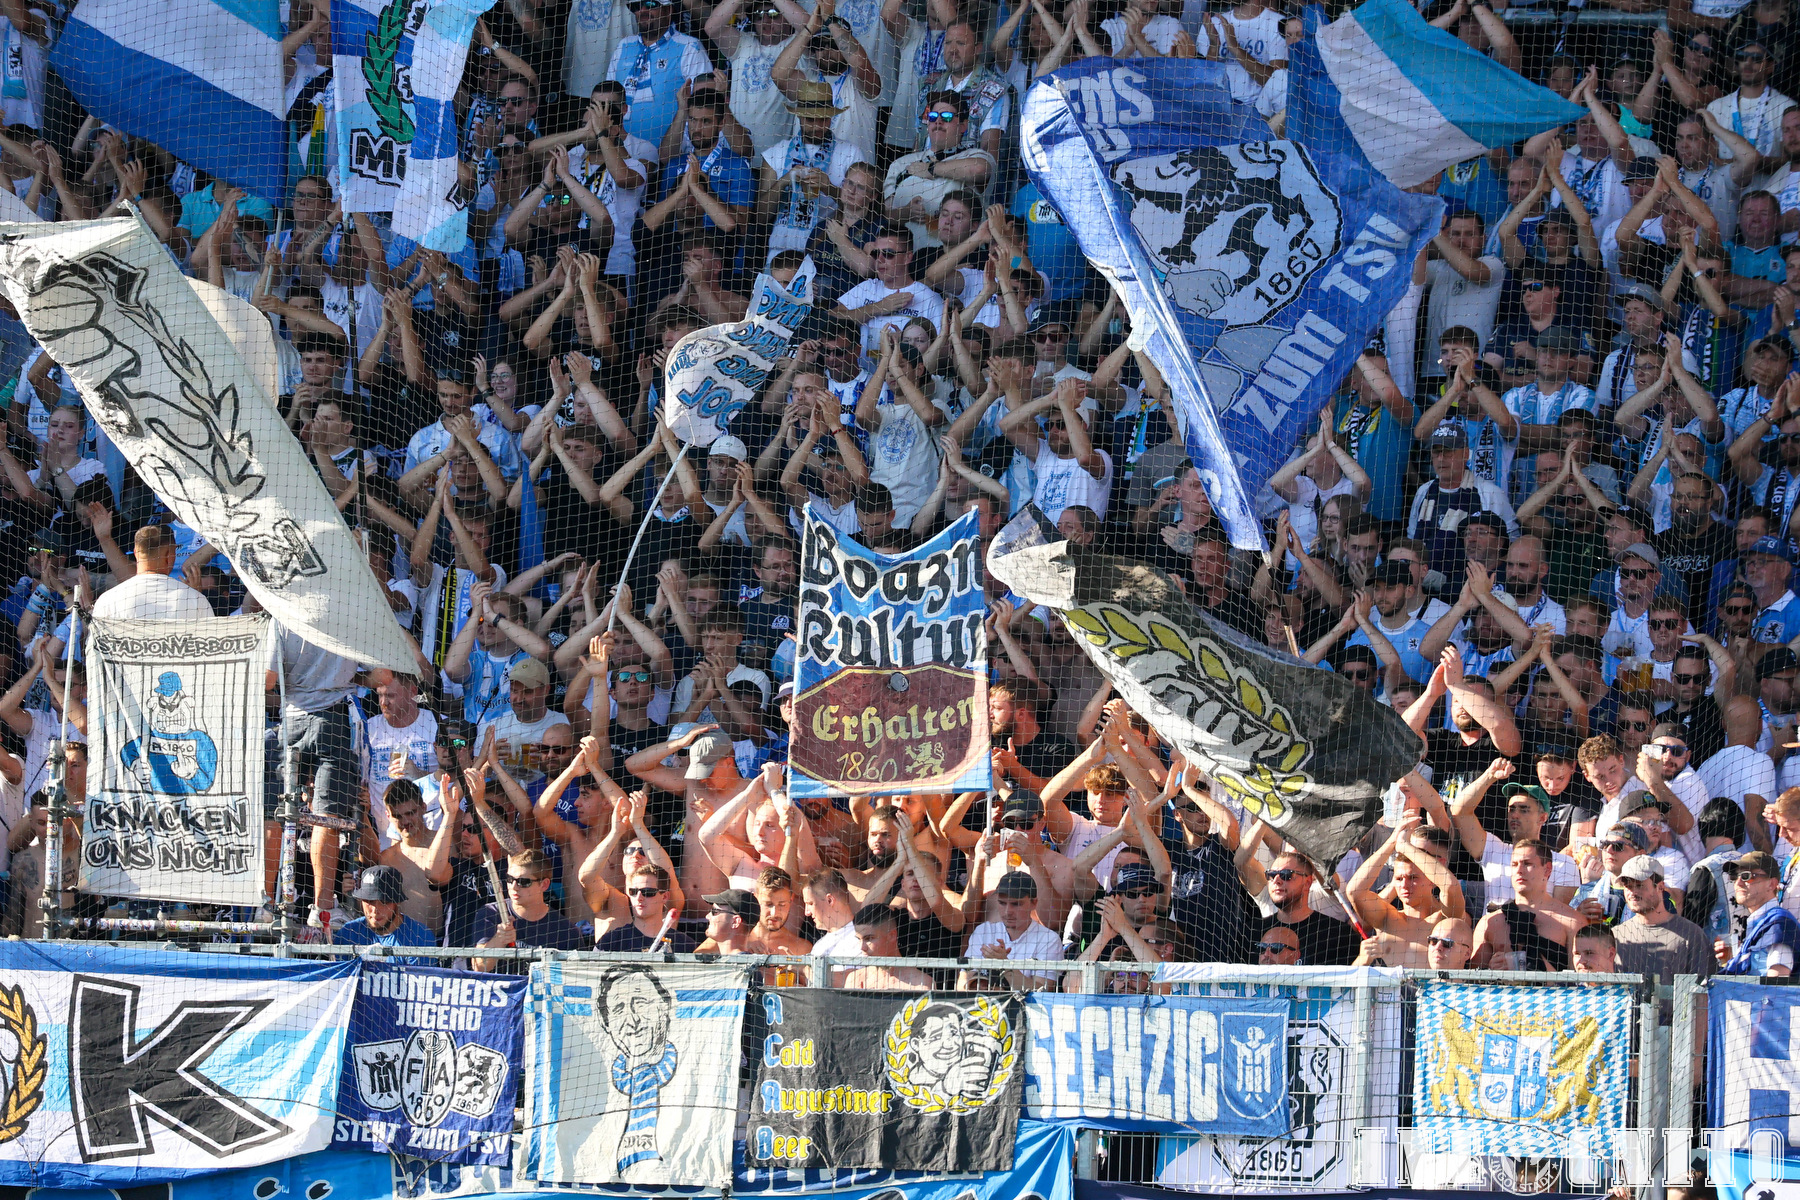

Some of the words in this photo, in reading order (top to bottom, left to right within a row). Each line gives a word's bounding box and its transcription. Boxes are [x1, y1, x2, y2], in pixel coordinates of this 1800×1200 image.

[1253, 236, 1322, 308] 1860
[812, 696, 974, 749] Erhalten
[837, 752, 898, 783] 1860
[90, 798, 251, 837] KNACKEN
[158, 838, 254, 875] NICHT
[361, 967, 511, 1008] MÜNCHENS
[395, 1001, 483, 1031] JUGEND
[68, 973, 293, 1163] K
[763, 1033, 815, 1068] Cold
[1024, 1004, 1219, 1122] SECHZIG
[760, 1080, 894, 1119] Augustiner
[467, 1131, 510, 1155] TSV
[756, 1125, 812, 1160] Beer
[1246, 1150, 1304, 1173] 1860
